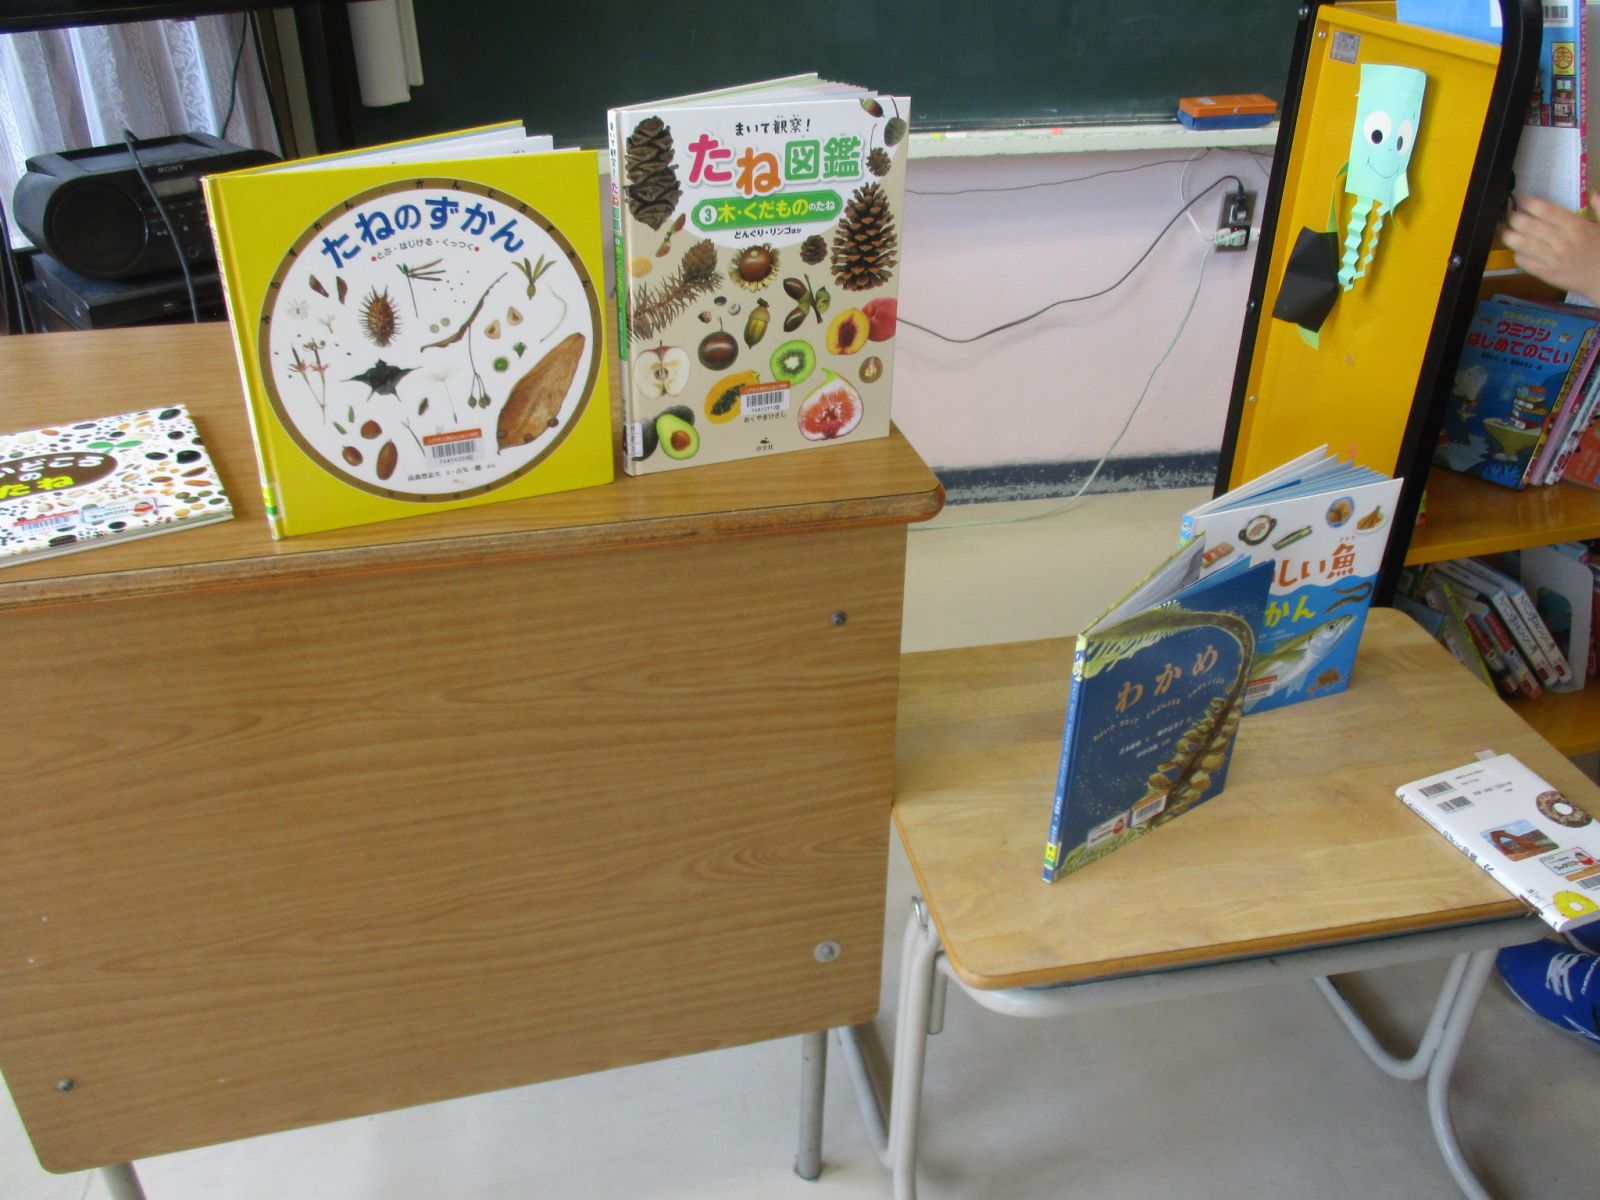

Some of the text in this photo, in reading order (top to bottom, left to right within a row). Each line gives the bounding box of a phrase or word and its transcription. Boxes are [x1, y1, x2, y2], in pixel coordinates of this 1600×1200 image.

[158, 164, 185, 174] SONY
[688, 133, 862, 196] たね図鑑
[321, 196, 525, 269] たねのずかん
[376, 237, 475, 260] とぶ・はじける・くっつく
[1467, 331, 1570, 364] はじめてのこい
[1496, 319, 1553, 343] ウミウシ
[1272, 543, 1356, 588] しい魚
[1113, 644, 1219, 713] わかめ
